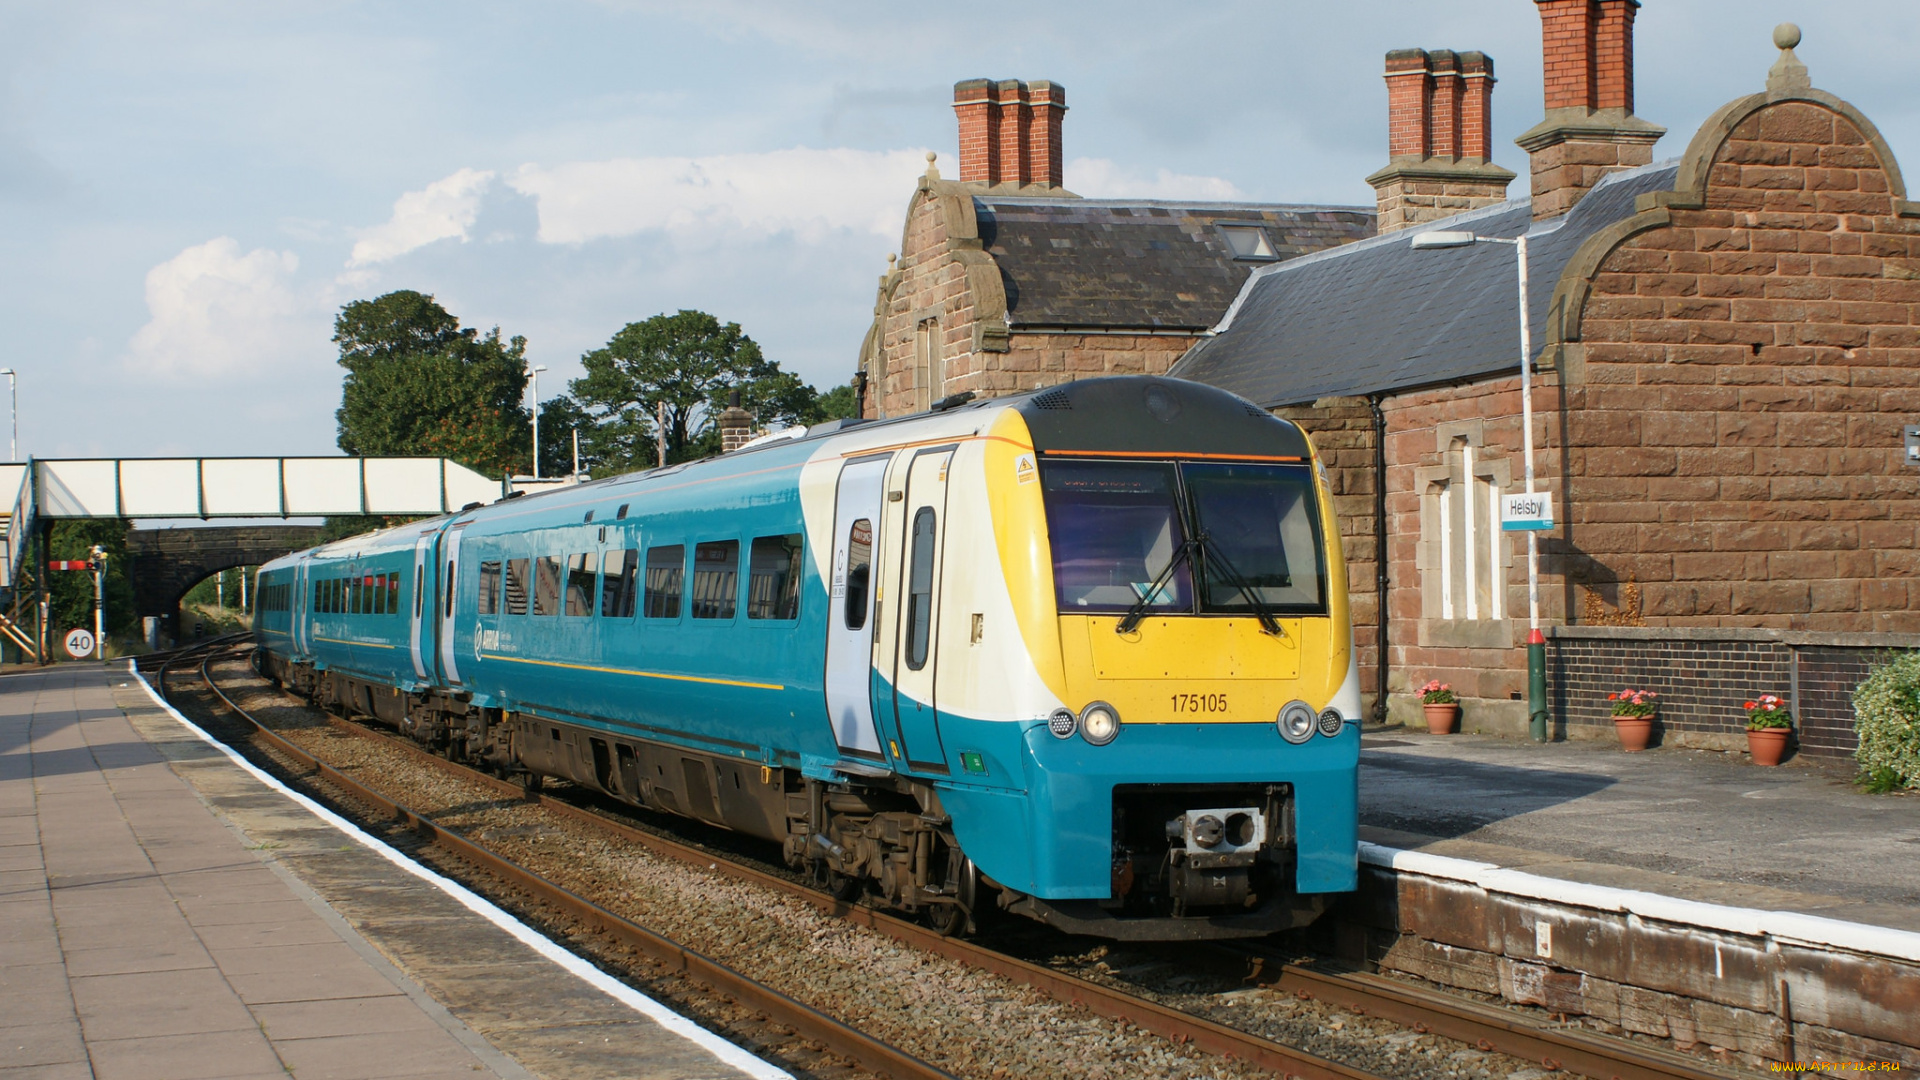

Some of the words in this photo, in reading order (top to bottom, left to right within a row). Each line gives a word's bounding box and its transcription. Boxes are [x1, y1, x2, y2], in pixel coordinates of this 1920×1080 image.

[1510, 498, 1542, 518] Helsby
[69, 636, 90, 650] 40
[1171, 693, 1227, 713] 175105
